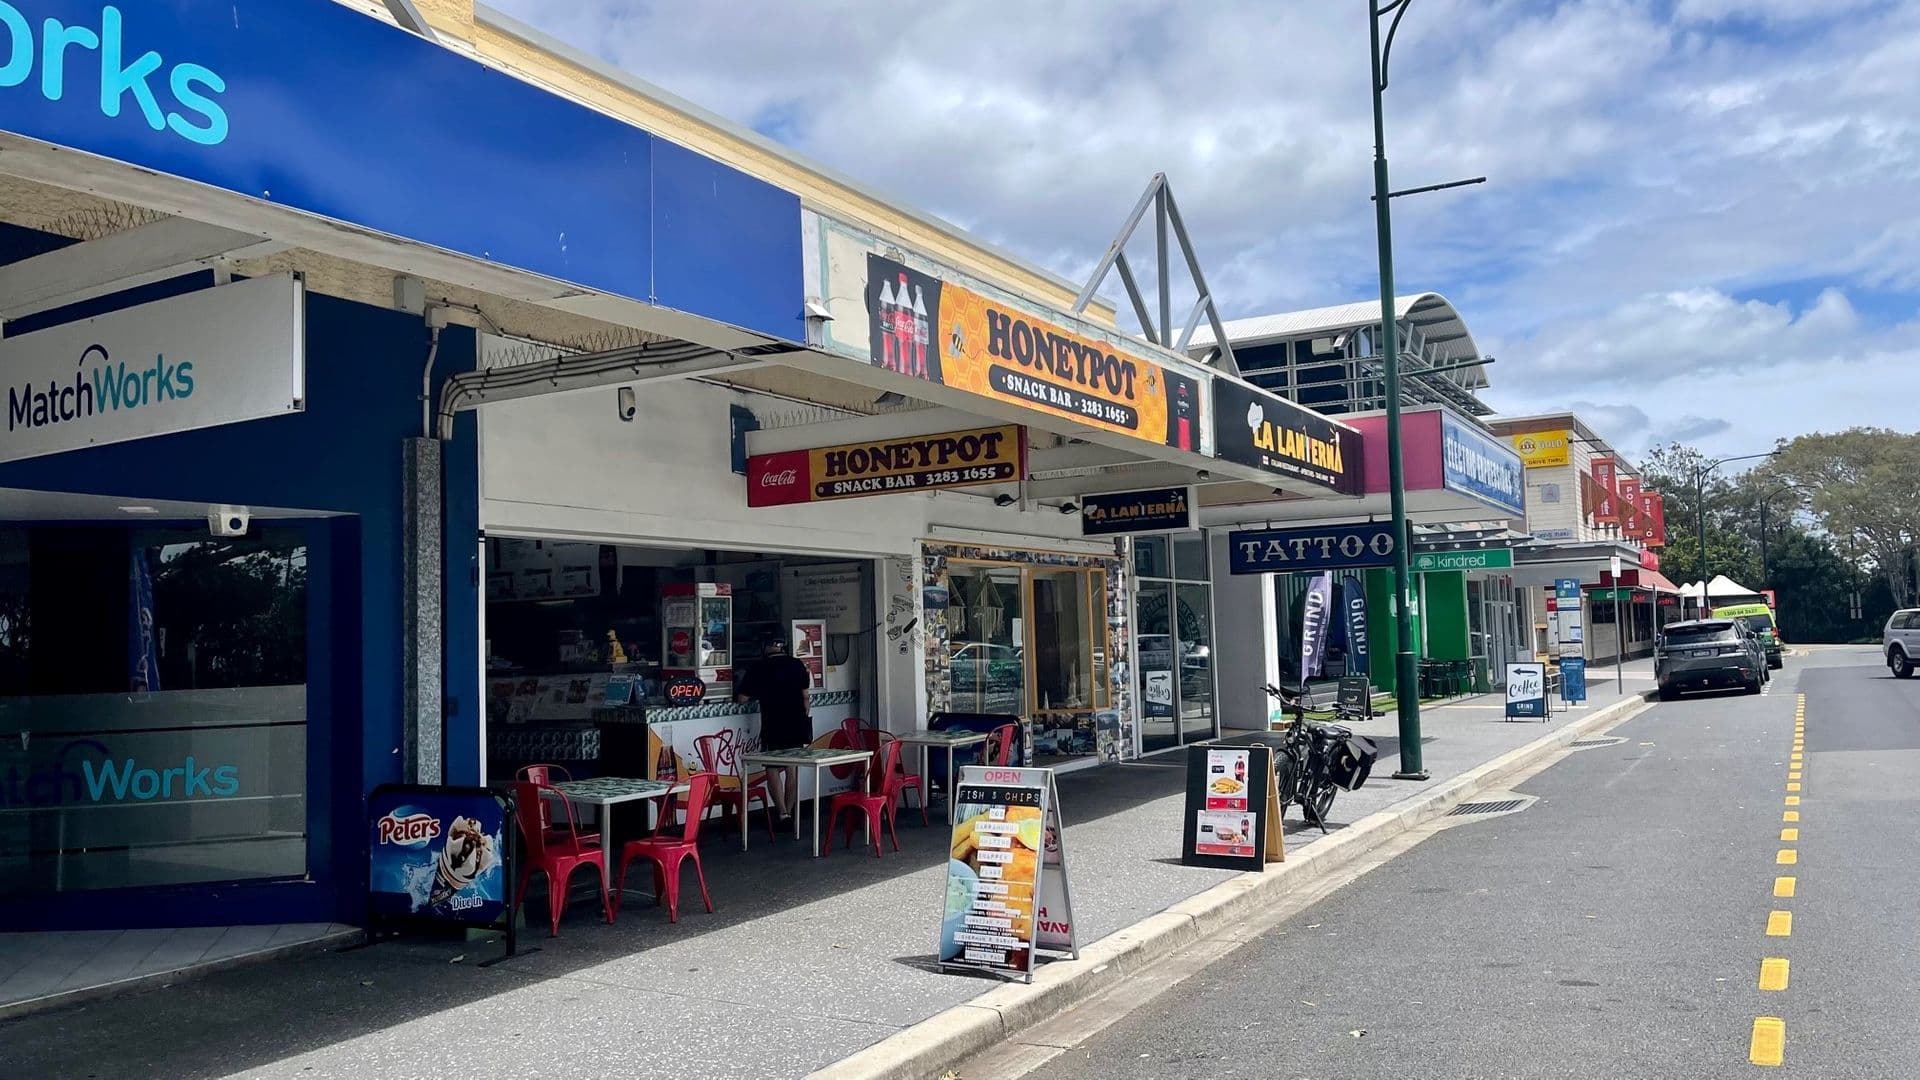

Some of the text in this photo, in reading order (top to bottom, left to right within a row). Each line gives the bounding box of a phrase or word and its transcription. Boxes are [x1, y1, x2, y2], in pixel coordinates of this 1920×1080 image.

[985, 308, 1138, 400] HONEYPOT
[9, 352, 194, 432] MatchWorks
[1006, 373, 1126, 424] SNACK BAR 3283 1655
[824, 431, 1004, 478] HONEYPOT
[1253, 420, 1275, 452] LA
[1277, 426, 1344, 474] LANTERNA
[761, 469, 797, 488] Coca-Cola
[833, 465, 996, 495] SNACK BAR 3283 1655
[1239, 532, 1395, 563] TATTOO
[1437, 554, 1486, 568] kindred
[1303, 589, 1325, 657] GRIND
[670, 685, 703, 698] OPEN
[1509, 679, 1539, 698] Coffee
[984, 771, 1022, 784] OPEN
[960, 790, 985, 800] FISH
[1005, 792, 1040, 803] CHIPS
[379, 816, 440, 844] Peters
[452, 896, 469, 910] Dive
